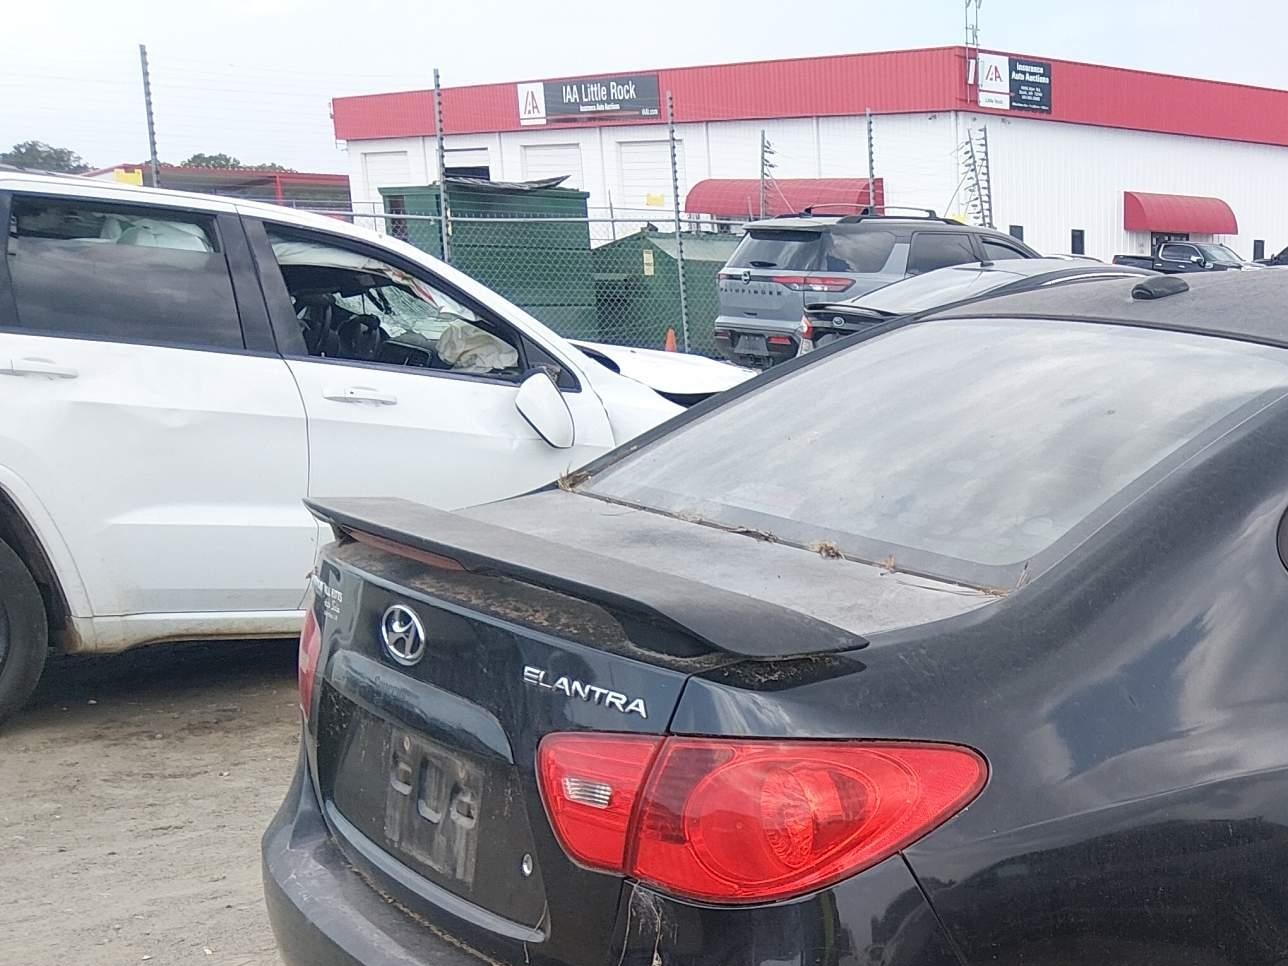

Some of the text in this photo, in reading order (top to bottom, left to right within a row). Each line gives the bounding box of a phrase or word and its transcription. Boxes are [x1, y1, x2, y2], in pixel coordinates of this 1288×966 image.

[562, 80, 637, 103] IAA Little Rock
[523, 665, 649, 719] ELANTRA
